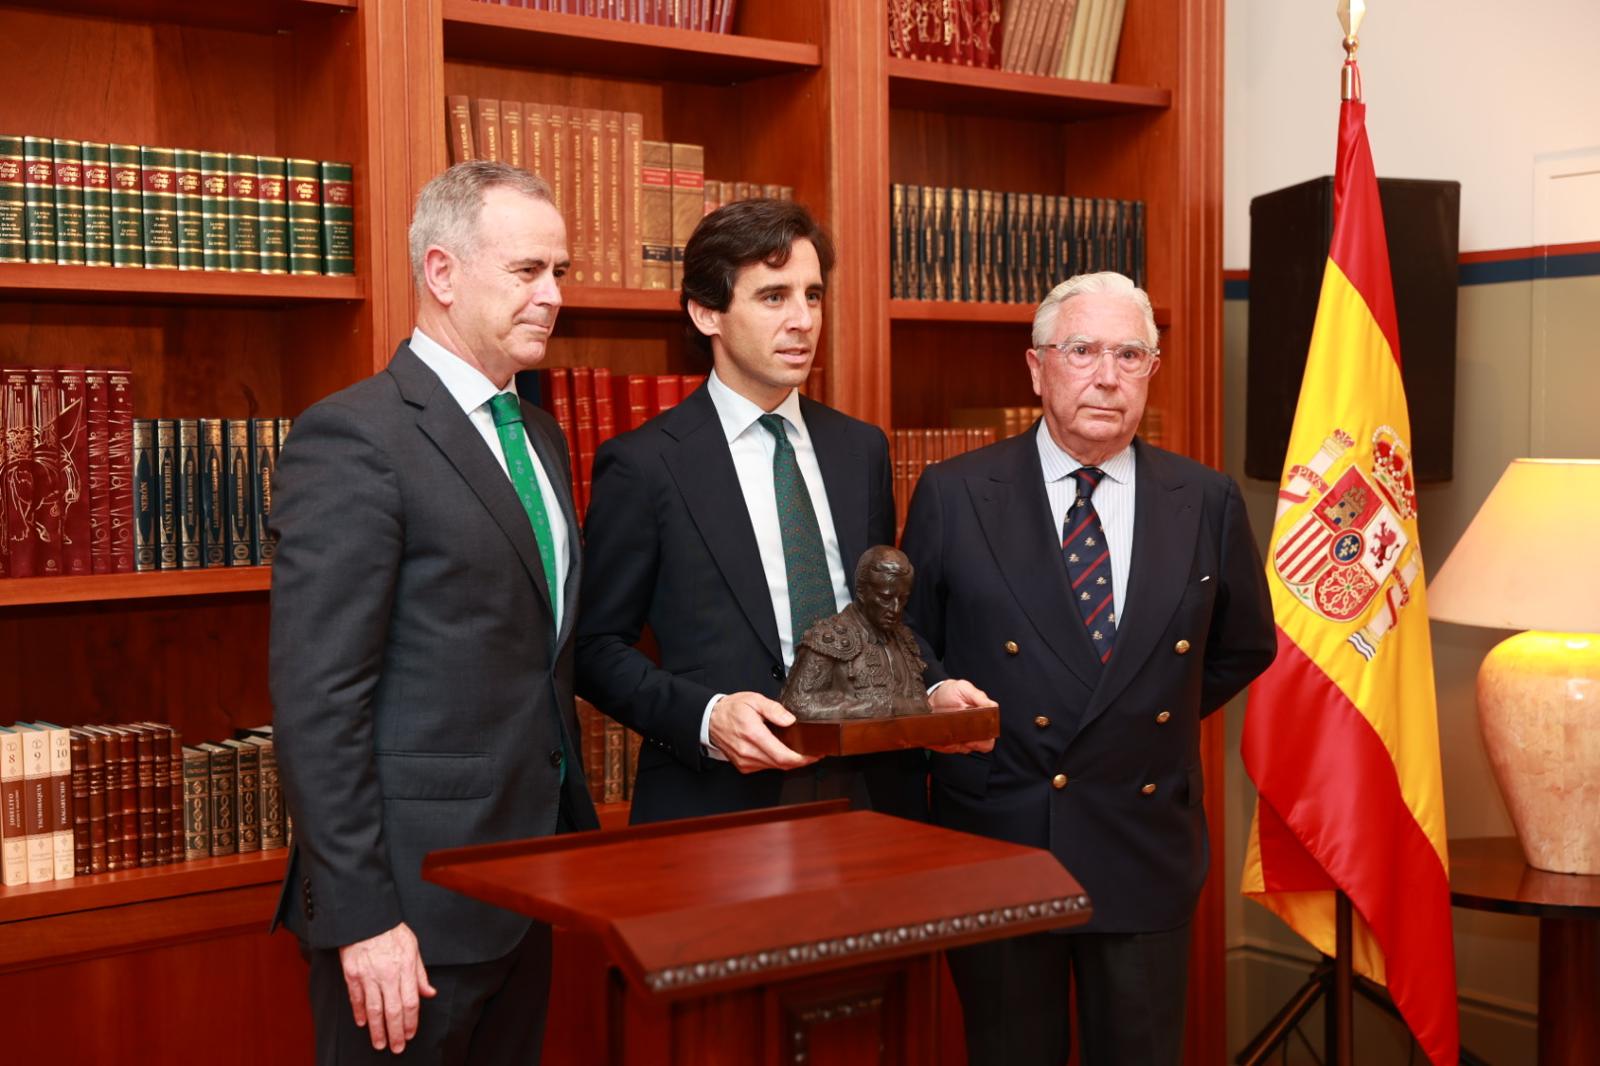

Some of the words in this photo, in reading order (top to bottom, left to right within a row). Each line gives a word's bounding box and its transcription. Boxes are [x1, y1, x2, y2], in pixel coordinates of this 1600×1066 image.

[164, 458, 172, 499] TERRIBLE
[1296, 466, 1321, 488] PLVS
[140, 481, 149, 512] NERÓN
[9, 753, 15, 763] 8
[56, 749, 67, 758] 10
